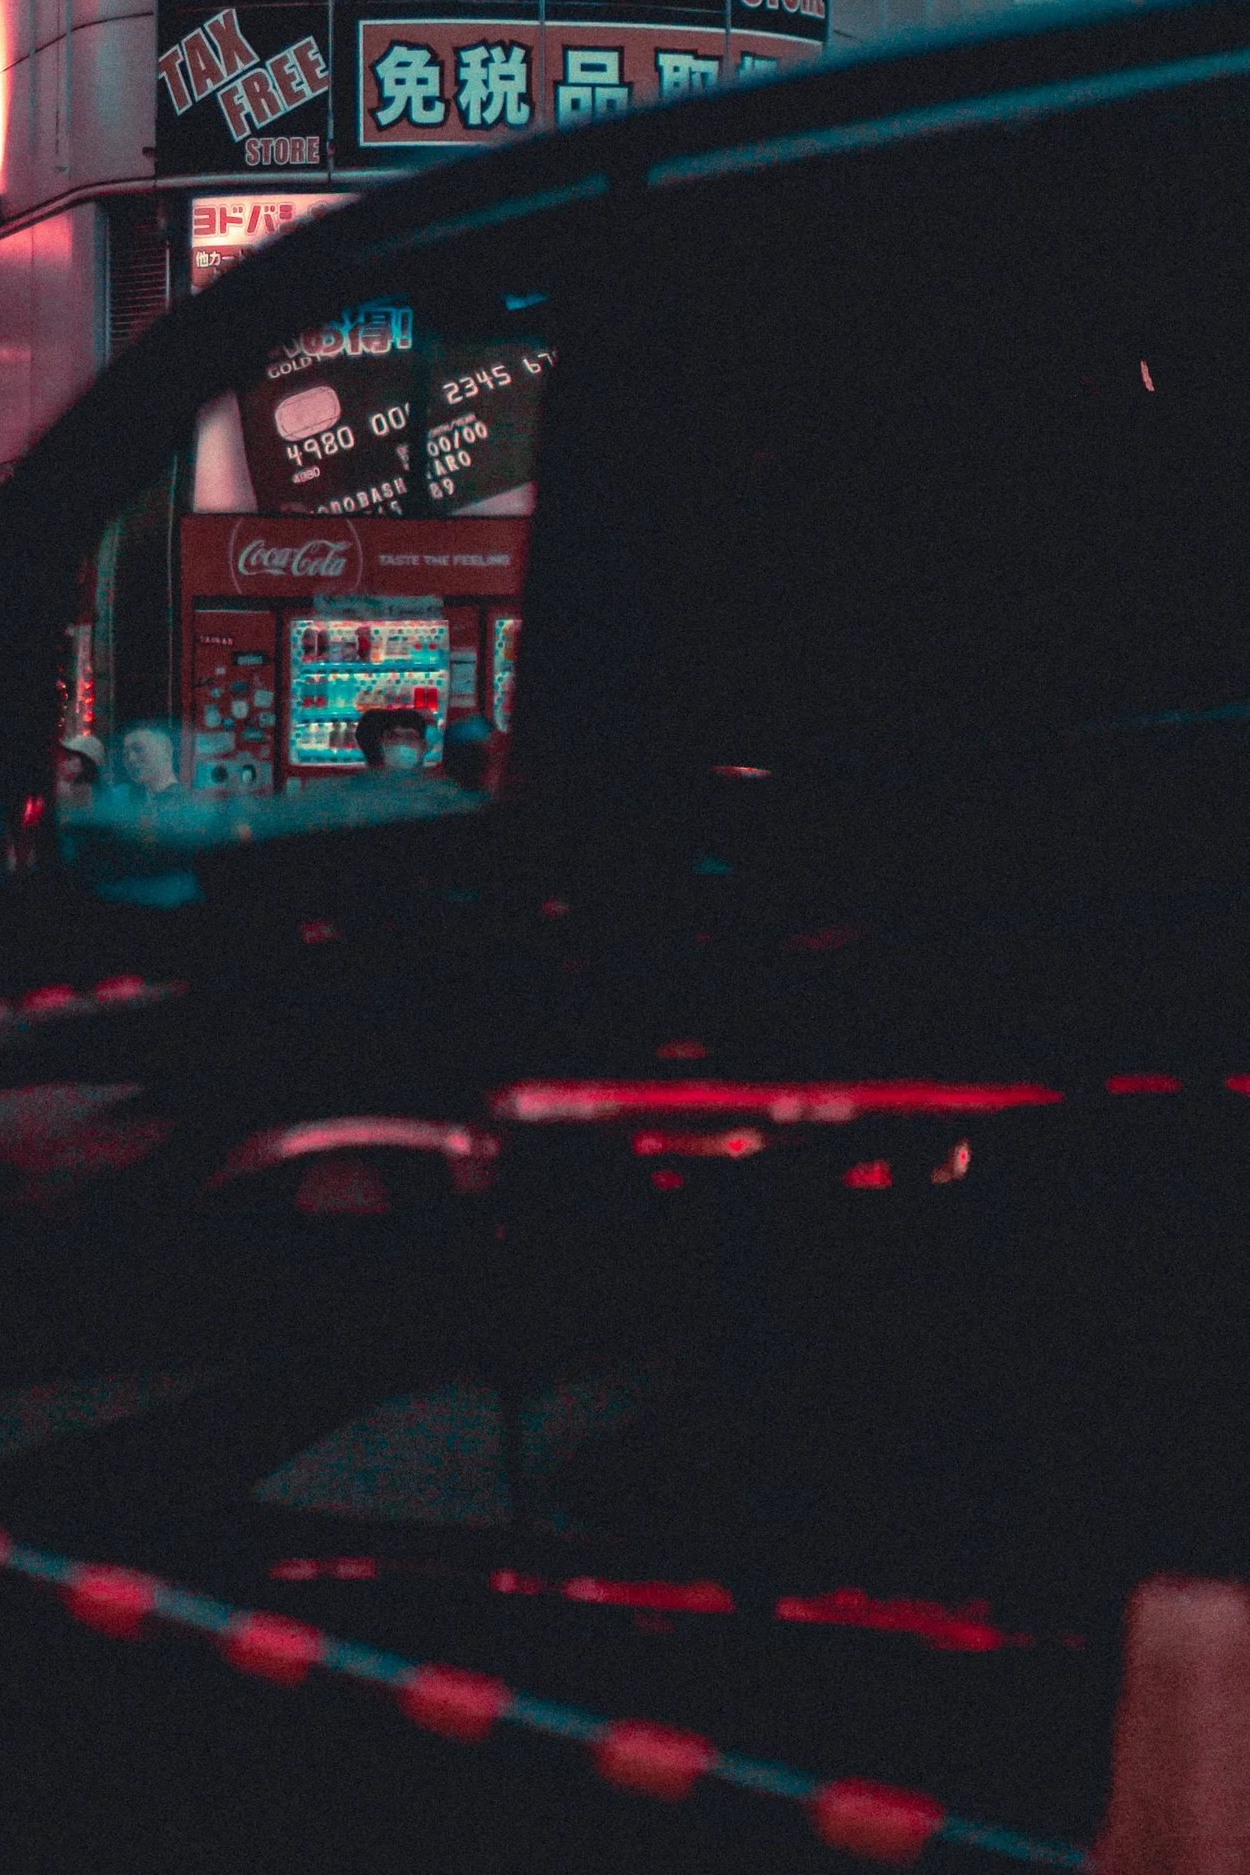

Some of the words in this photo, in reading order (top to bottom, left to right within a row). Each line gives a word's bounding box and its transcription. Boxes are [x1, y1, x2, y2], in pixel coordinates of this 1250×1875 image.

[158, 7, 260, 117] TAX
[216, 34, 330, 142] FREE
[245, 135, 320, 165] STORE
[267, 356, 312, 379] GOLD
[442, 365, 512, 405] 2345
[286, 426, 355, 467] 4980
[427, 420, 488, 457] 00/00
[427, 449, 472, 479] ARO
[237, 538, 352, 577] Coca-Cola
